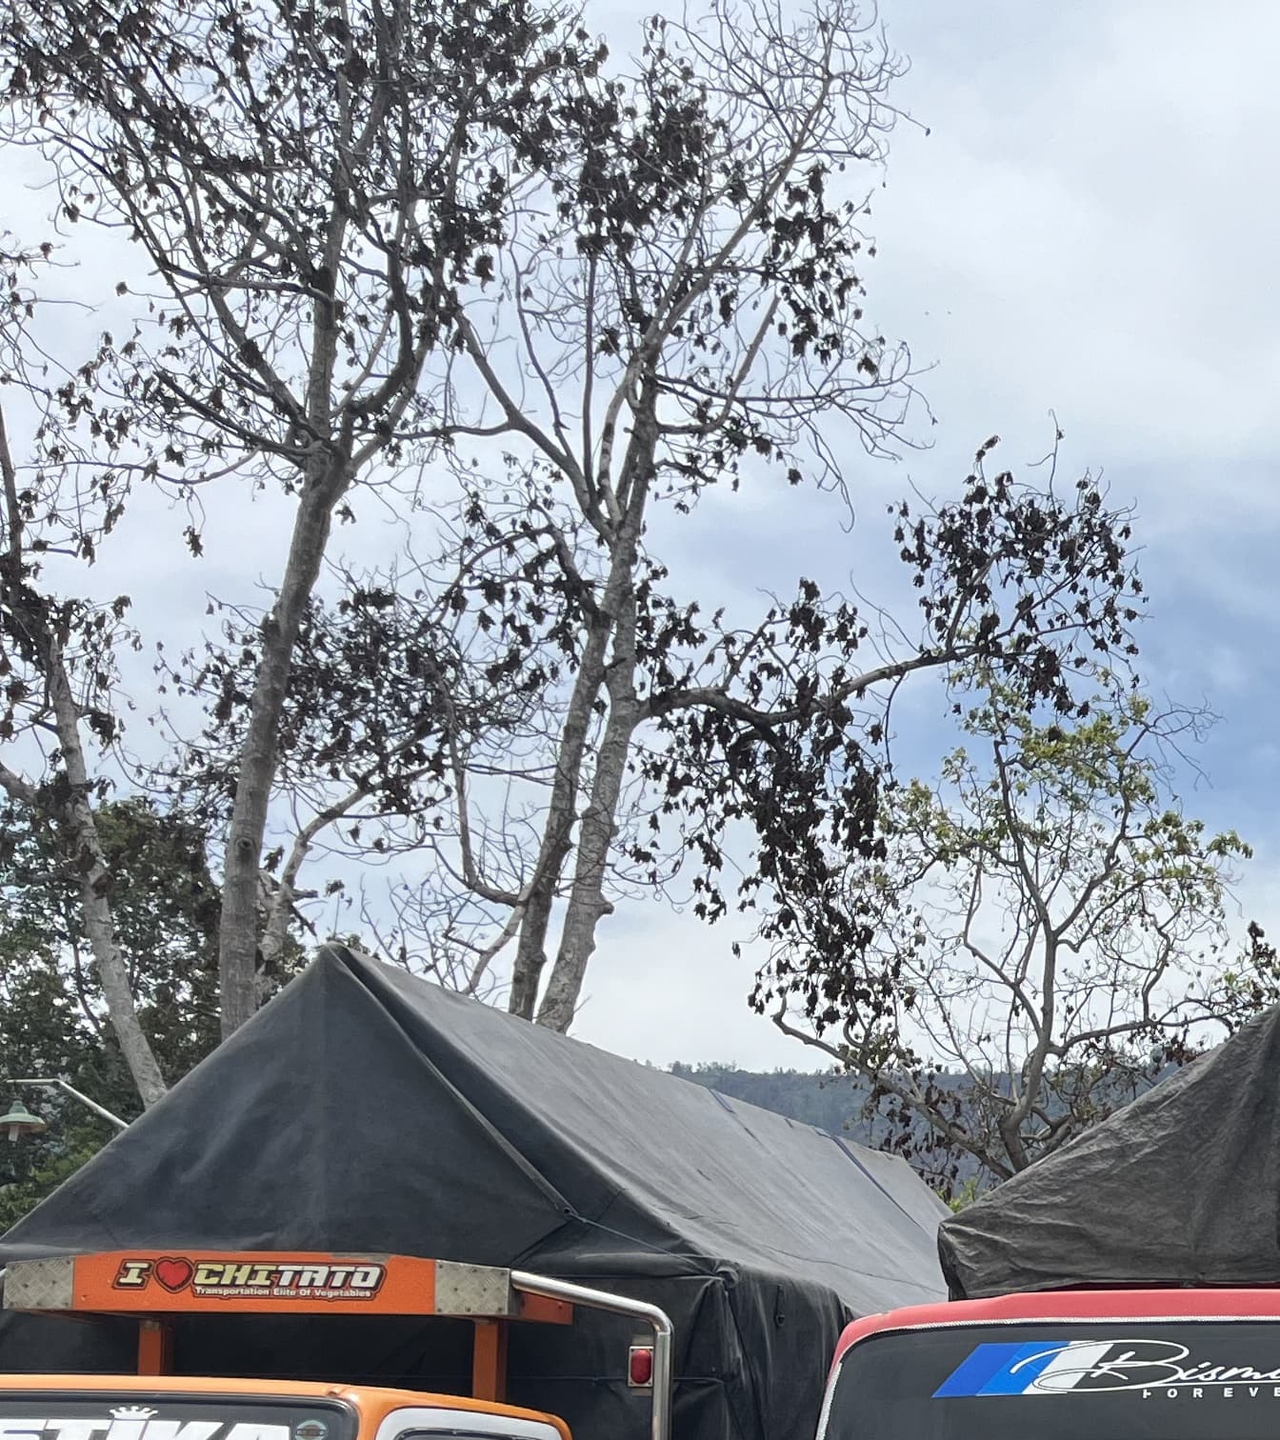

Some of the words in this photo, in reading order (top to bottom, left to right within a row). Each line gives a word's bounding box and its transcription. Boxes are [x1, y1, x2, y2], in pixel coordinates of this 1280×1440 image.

[119, 1262, 151, 1285] I
[193, 1263, 381, 1288] CHITATO
[195, 1287, 269, 1297] Transportation
[273, 1287, 296, 1297] Elite
[299, 1288, 311, 1297] Of
[315, 1288, 371, 1299] Vegetables
